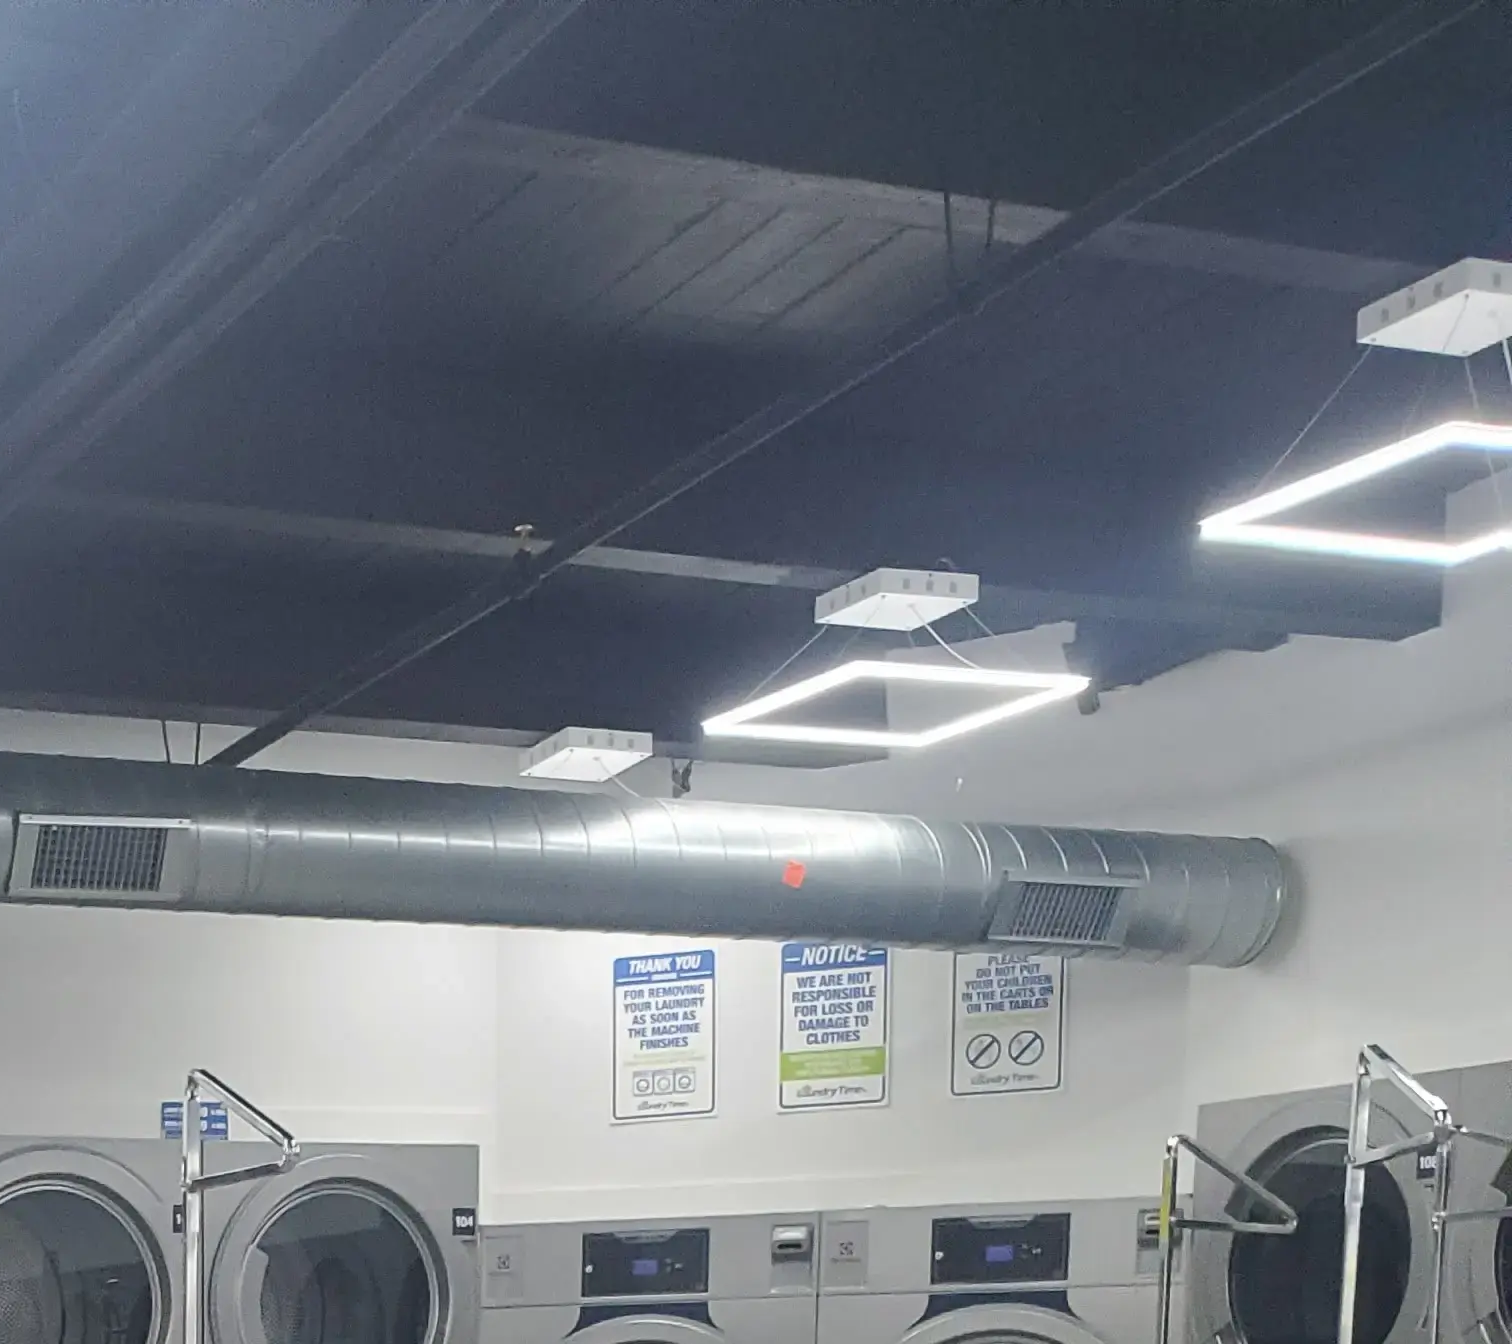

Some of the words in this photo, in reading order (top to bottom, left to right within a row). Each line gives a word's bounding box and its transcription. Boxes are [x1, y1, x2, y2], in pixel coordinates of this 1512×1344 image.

[801, 944, 867, 966] NOTICE
[629, 957, 673, 975] THANK
[674, 955, 701, 970] YOU
[995, 965, 1016, 976] NOT
[1020, 963, 1041, 974] PUT
[797, 976, 816, 989] WE
[819, 974, 844, 987] ARE
[848, 972, 872, 985] NOT
[965, 979, 993, 991] YOUR
[997, 975, 1053, 988] CHILDREN
[624, 989, 644, 1000] FOR
[648, 984, 705, 998] REMOVING
[792, 986, 876, 1003] RESPONSIBLE
[976, 990, 996, 1001] THE
[1000, 987, 1036, 999] CARTS
[624, 1001, 652, 1013] YOUR
[655, 997, 705, 1010] LAUNDRY
[794, 1005, 818, 1017] FOR
[822, 1002, 853, 1015] LOSS
[856, 1000, 874, 1012] OR
[985, 1001, 1005, 1012] THE
[1009, 997, 1049, 1010] TABLES
[632, 1014, 646, 1025] AS
[650, 1012, 679, 1024] SOON
[682, 1010, 696, 1020] AS
[798, 1018, 851, 1031] DAMAGE
[853, 1014, 869, 1028] TO
[628, 1027, 648, 1038] THE
[651, 1022, 700, 1036] MACHINE
[806, 1030, 861, 1045] CLOTHES
[639, 1036, 689, 1051] FINISHES
[455, 1215, 474, 1228] 104
